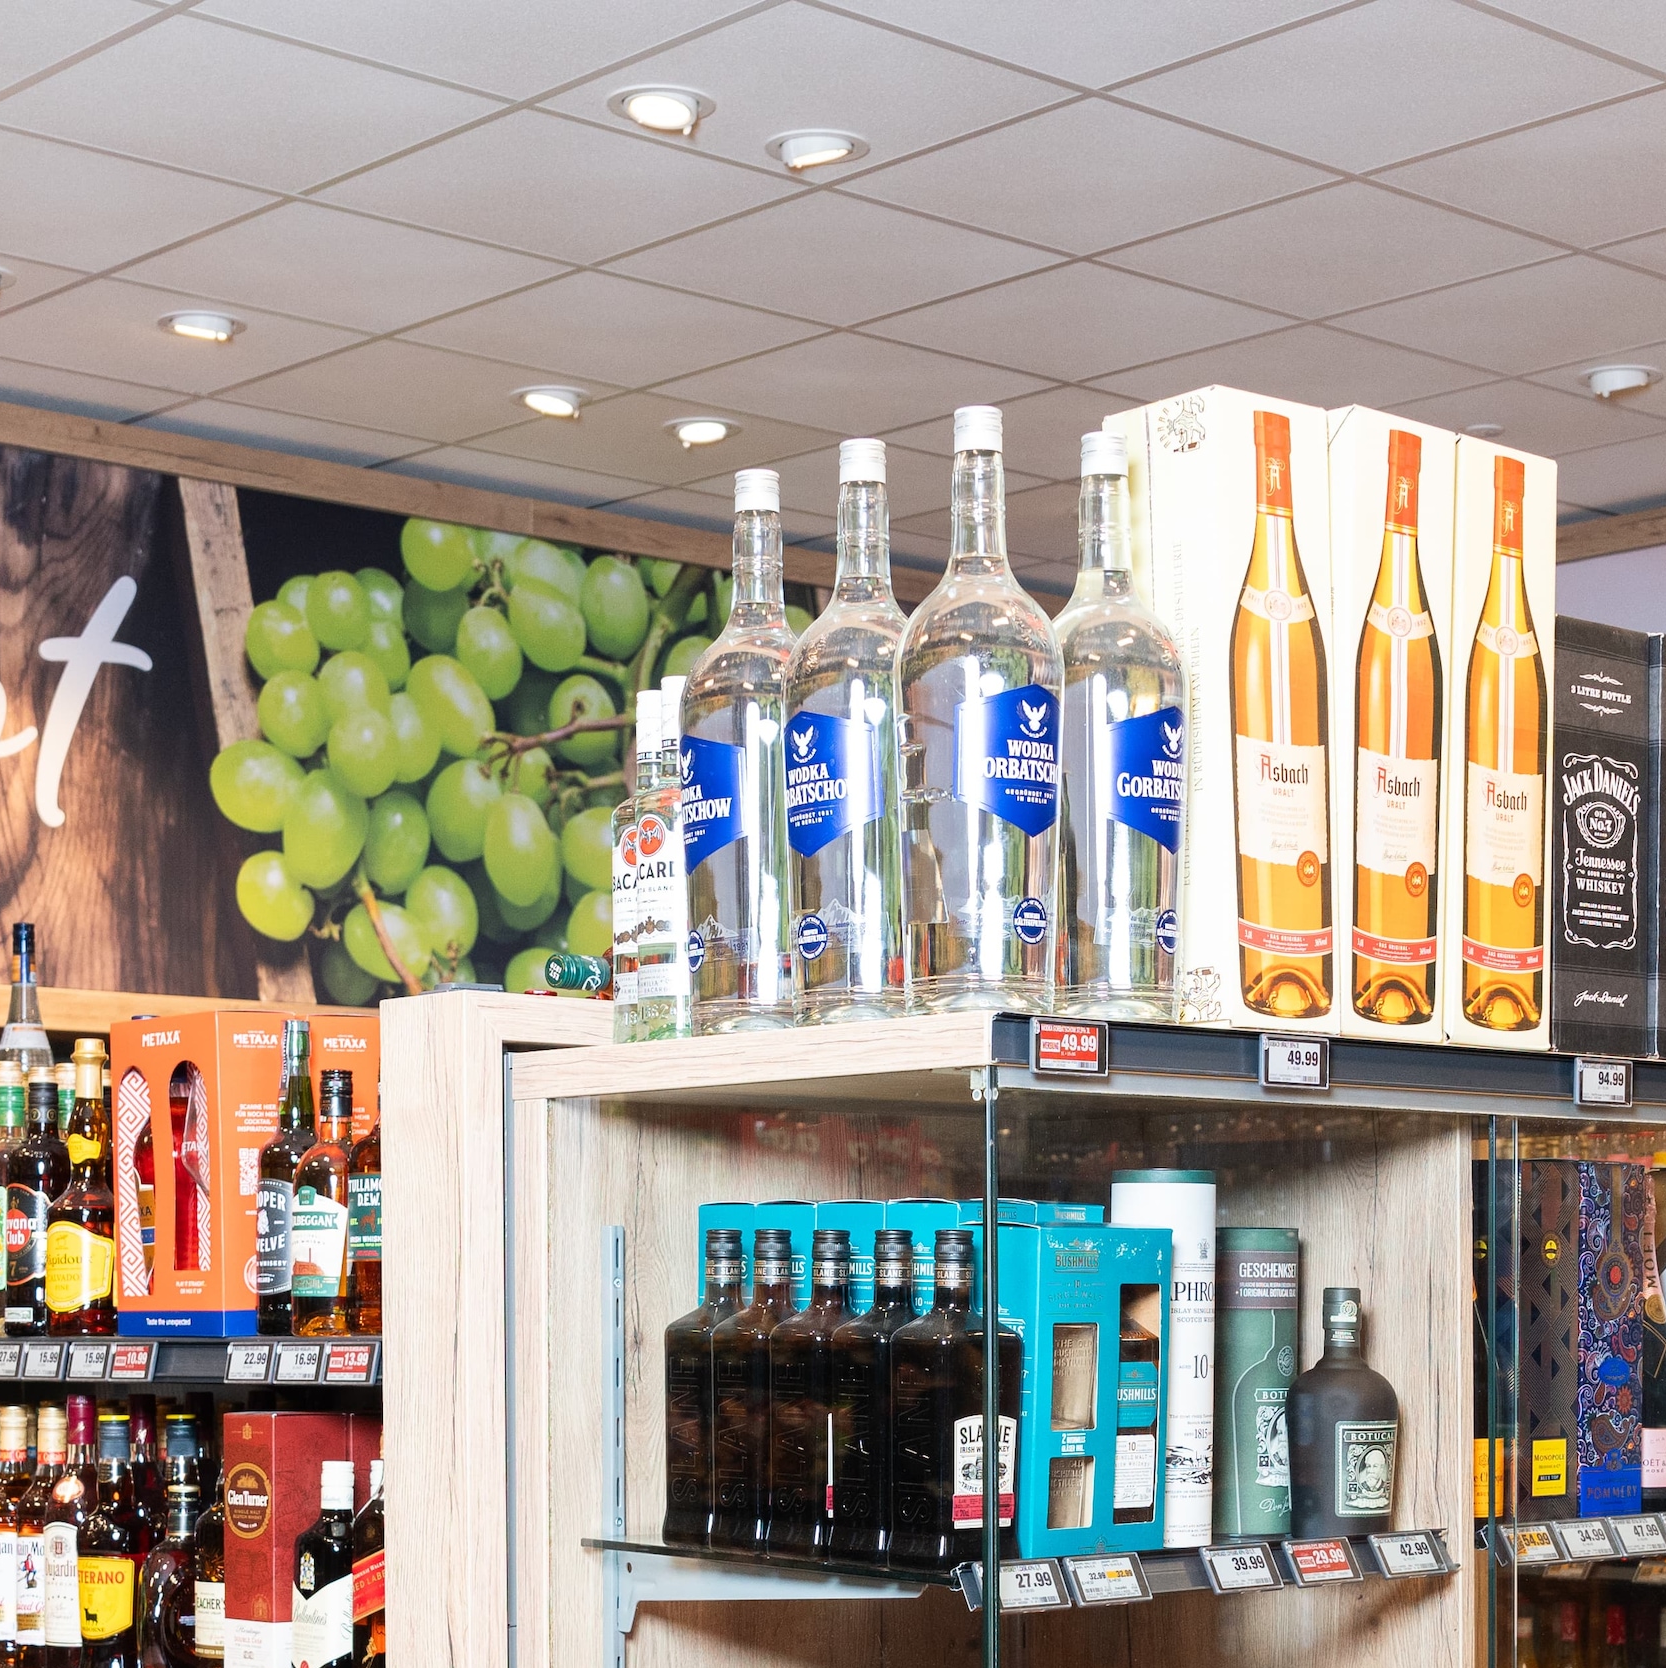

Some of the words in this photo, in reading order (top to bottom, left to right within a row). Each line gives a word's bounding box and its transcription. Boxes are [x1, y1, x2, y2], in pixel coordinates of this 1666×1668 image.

[1571, 685, 1576, 693] 3
[1579, 687, 1600, 698] LITRE
[1603, 690, 1631, 704] BOTTLE
[1007, 740, 1054, 760] WODKA
[788, 763, 829, 784] WODKA
[1259, 754, 1309, 785] Asbach
[1377, 767, 1420, 797] Asbach
[1562, 767, 1592, 805] JACK
[1273, 788, 1294, 797] URALT
[1486, 781, 1527, 811] Asbach
[1387, 801, 1406, 810] URALT
[1496, 813, 1514, 823] URALT
[1575, 848, 1626, 871] Tennessee
[1576, 878, 1625, 895] WHISKEY
[142, 1030, 181, 1048] METAXA
[233, 1034, 278, 1045] METAXA
[324, 1038, 367, 1049] METAXA
[1061, 1033, 1096, 1051] 49.99
[1287, 1051, 1318, 1066] 49.99
[1598, 1071, 1624, 1086] 94.99
[127, 1352, 147, 1366] 10.99
[294, 1353, 316, 1365] 16.99
[344, 1352, 368, 1367] 13.99
[1193, 1354, 1208, 1379] 10
[1578, 1530, 1606, 1542] 34.99
[1634, 1524, 1660, 1537] 47.99
[1521, 1534, 1550, 1547] 54.99
[1400, 1542, 1429, 1557] 42.99
[1234, 1556, 1265, 1571] 39.99
[1015, 1572, 1052, 1587] 27.99
